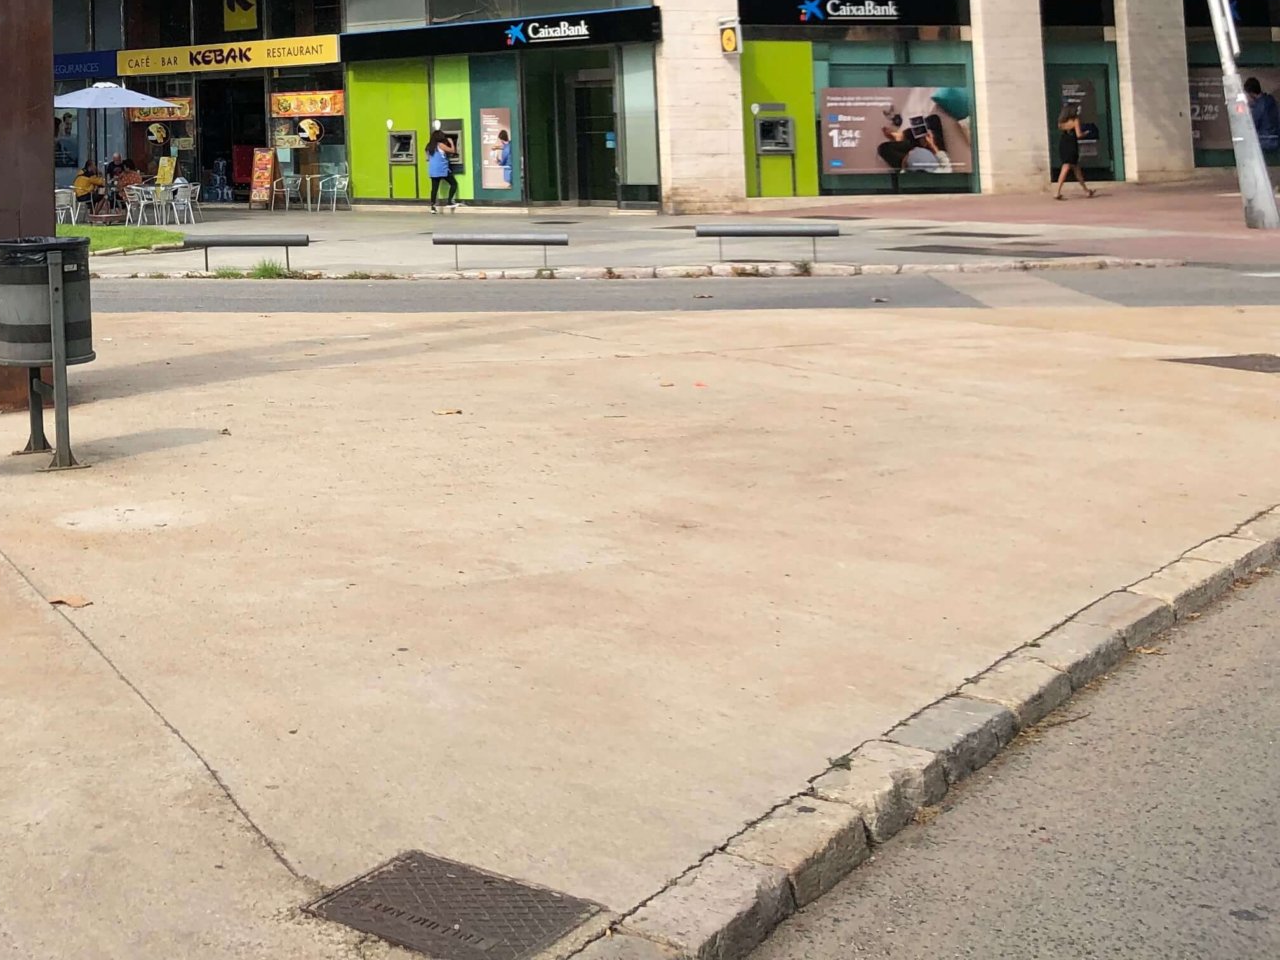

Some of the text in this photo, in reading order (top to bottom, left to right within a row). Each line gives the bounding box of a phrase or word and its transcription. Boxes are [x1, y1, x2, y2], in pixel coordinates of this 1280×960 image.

[826, 0, 900, 16] CaixaBank
[528, 20, 590, 38] CaixaBank
[128, 56, 150, 69] CAFÉ
[161, 56, 178, 67] BAR
[188, 47, 252, 67] KEBAK
[266, 44, 324, 59] RESTAURANT
[55, 62, 100, 75] EGURANCES
